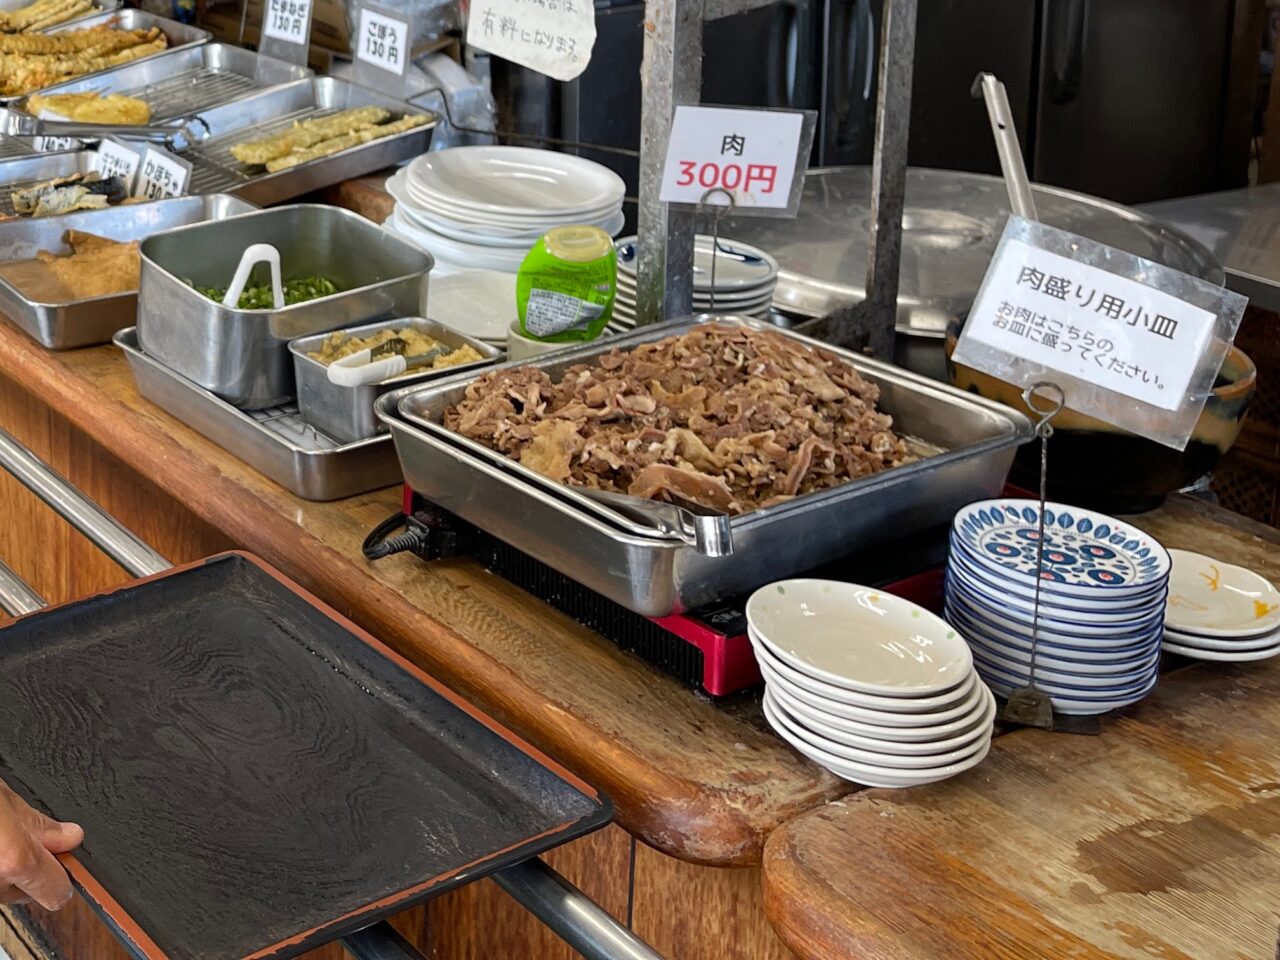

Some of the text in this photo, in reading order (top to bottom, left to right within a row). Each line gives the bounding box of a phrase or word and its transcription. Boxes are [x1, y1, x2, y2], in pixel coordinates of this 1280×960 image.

[272, 13, 302, 37] 130円
[367, 19, 399, 46] ごぼう
[481, 7, 579, 64] 有料になります。
[365, 38, 399, 66] 130円
[720, 133, 746, 157] 肉
[144, 159, 179, 192] かぼちゃ
[675, 160, 779, 195] 300円
[1016, 264, 1179, 341] 肉盛り用小皿
[996, 300, 1115, 354] お肉はこちらの
[992, 313, 1165, 391] お皿に盛ってください。
